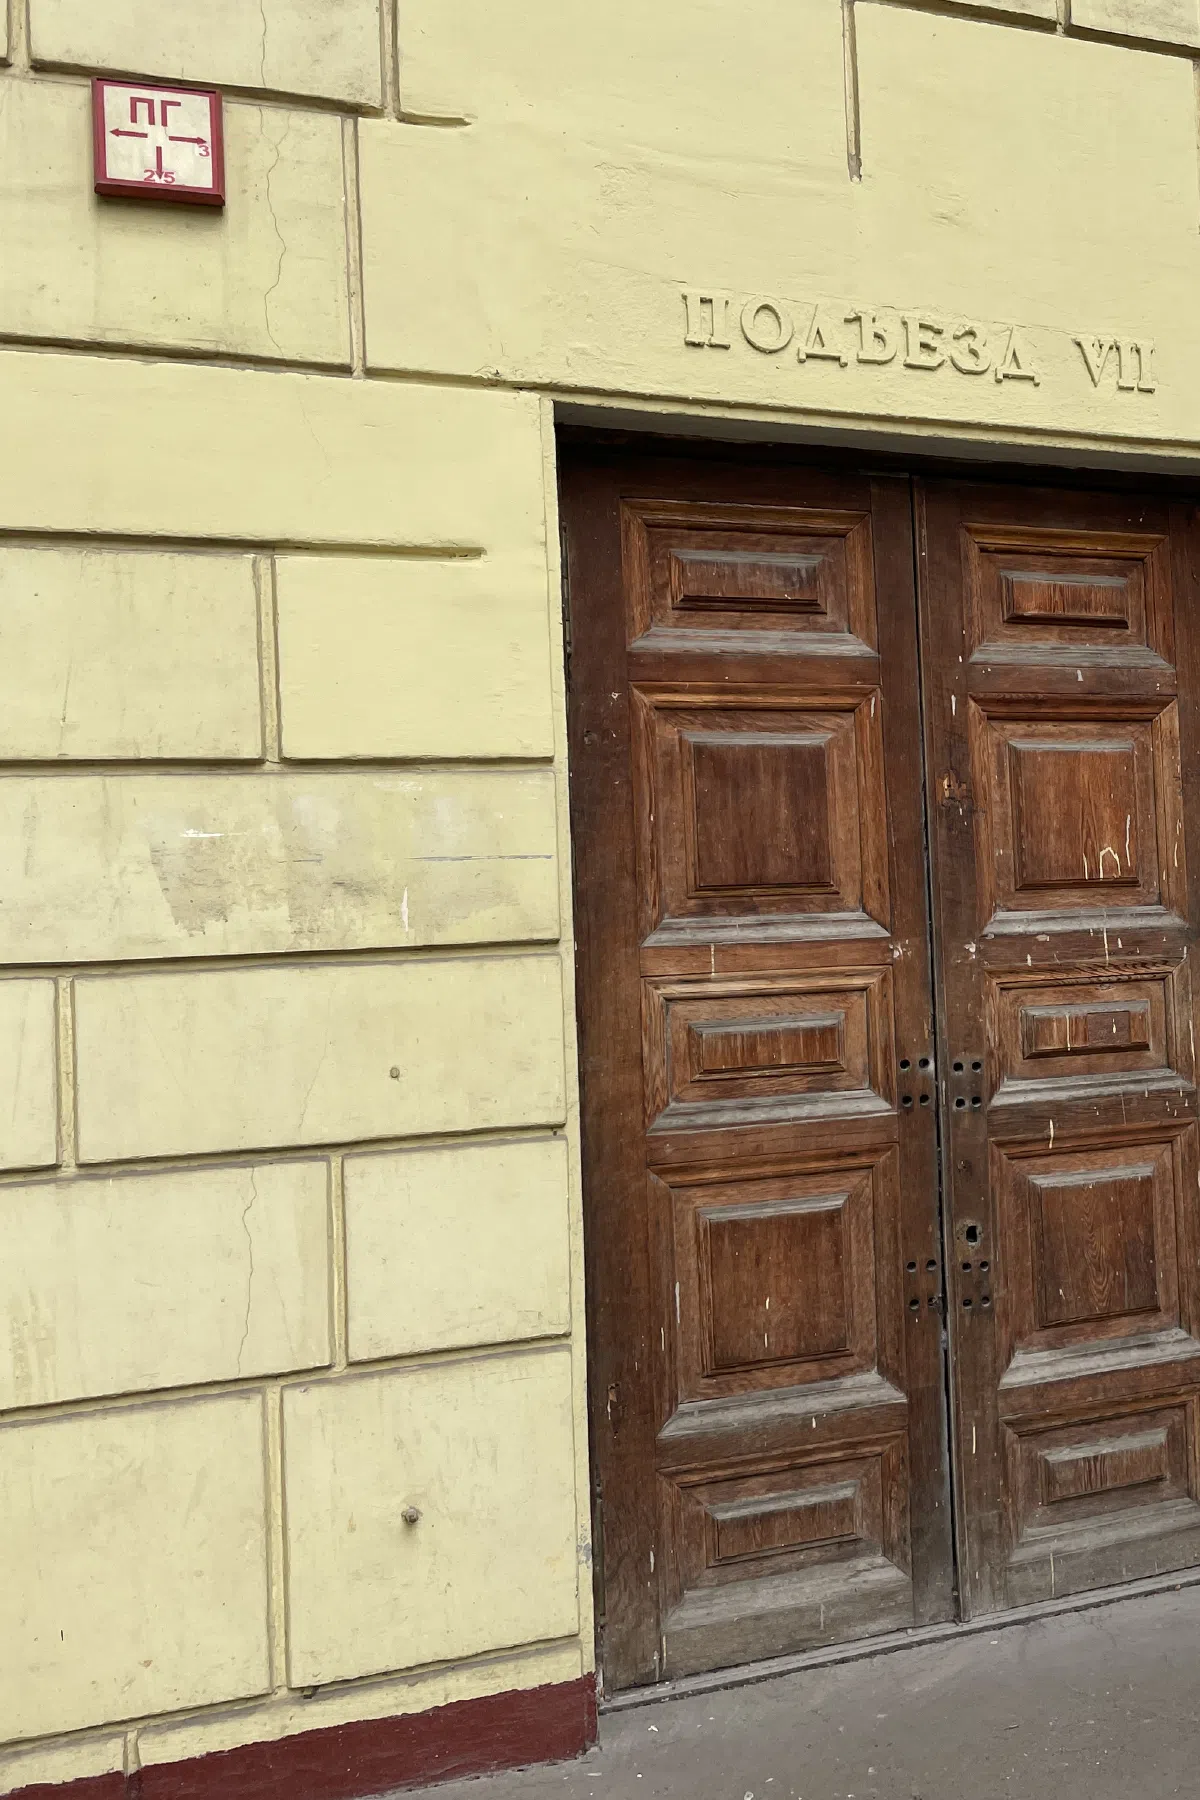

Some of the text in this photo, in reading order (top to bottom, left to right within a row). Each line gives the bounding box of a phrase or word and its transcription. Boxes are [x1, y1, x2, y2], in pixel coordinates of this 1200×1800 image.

[129, 96, 182, 127] ПГ
[198, 145, 210, 157] 3
[681, 292, 1156, 394] ПОДЪЕЗД VII
